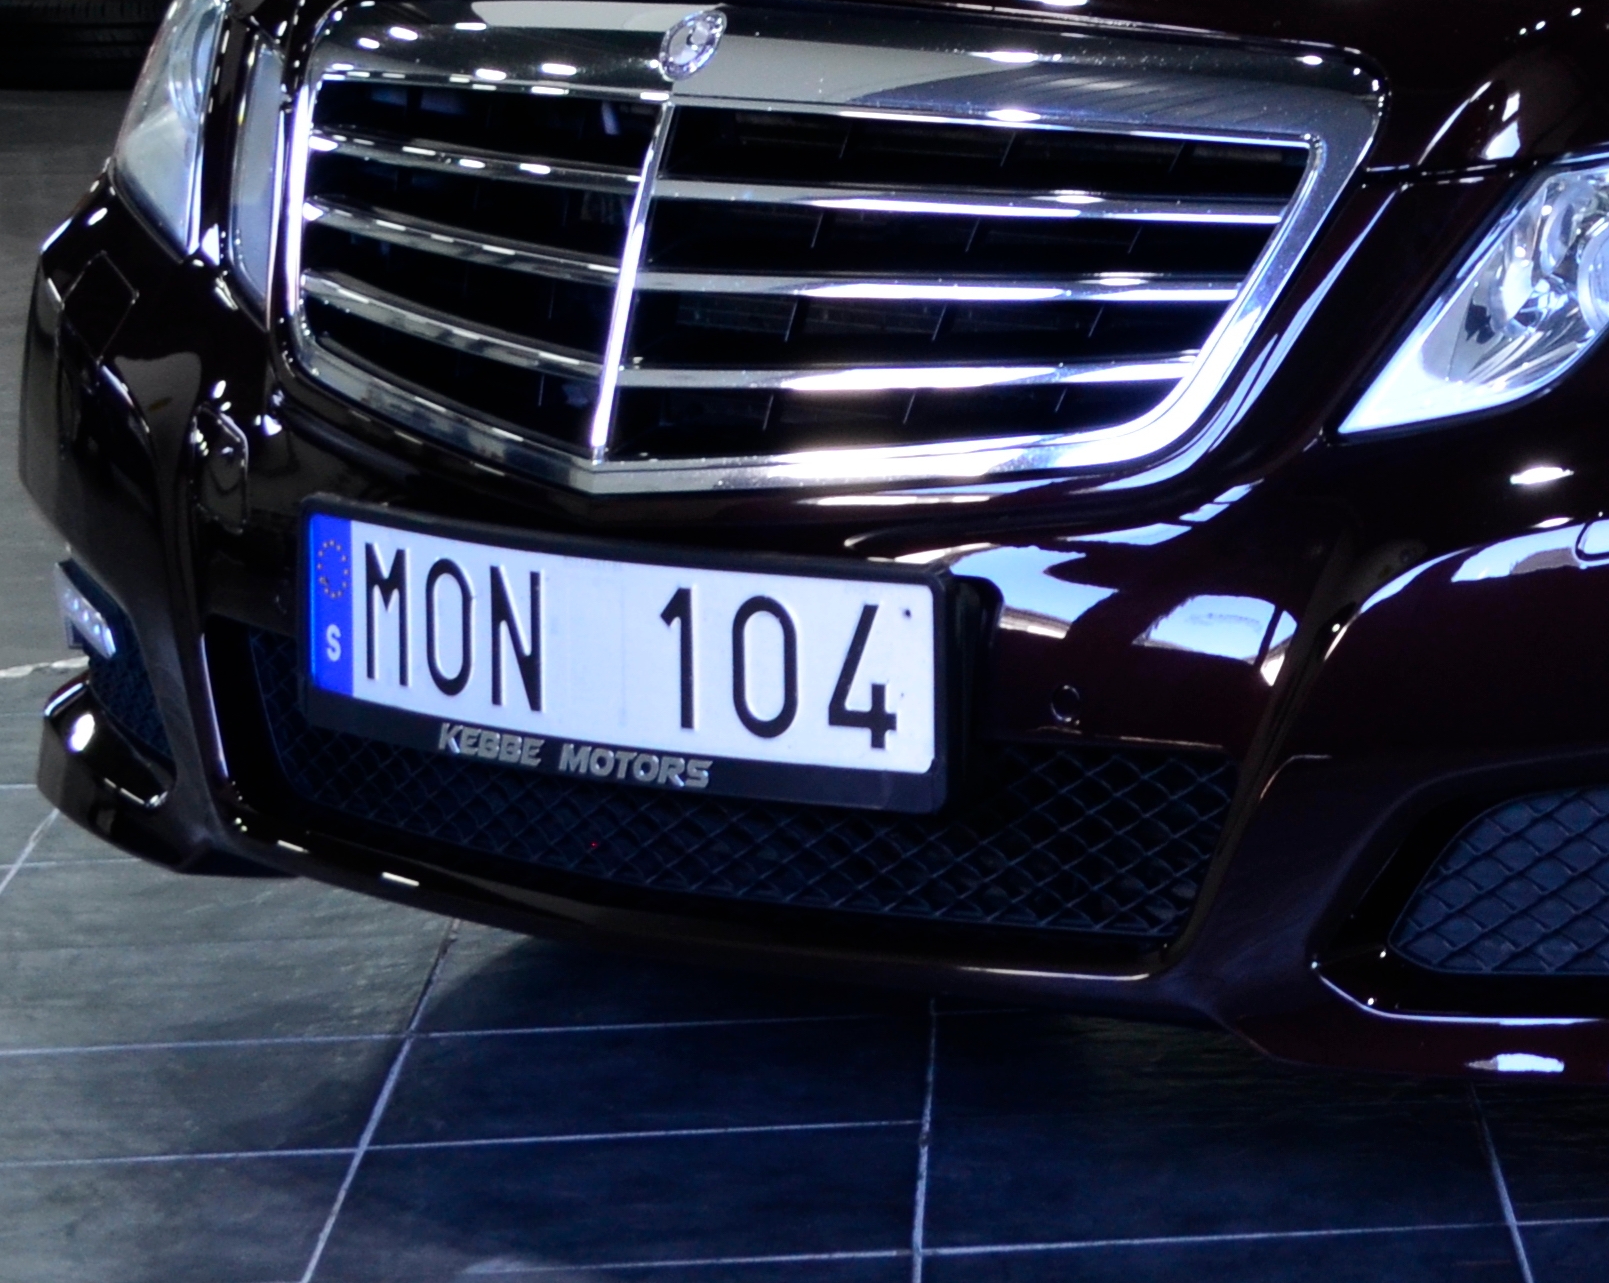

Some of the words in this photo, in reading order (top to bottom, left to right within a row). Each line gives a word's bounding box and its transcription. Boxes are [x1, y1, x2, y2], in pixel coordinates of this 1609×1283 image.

[326, 623, 342, 662] S
[364, 542, 543, 713] MON
[660, 586, 898, 750] 104
[438, 722, 545, 767] KEBBE
[559, 742, 713, 789] MOTORS
